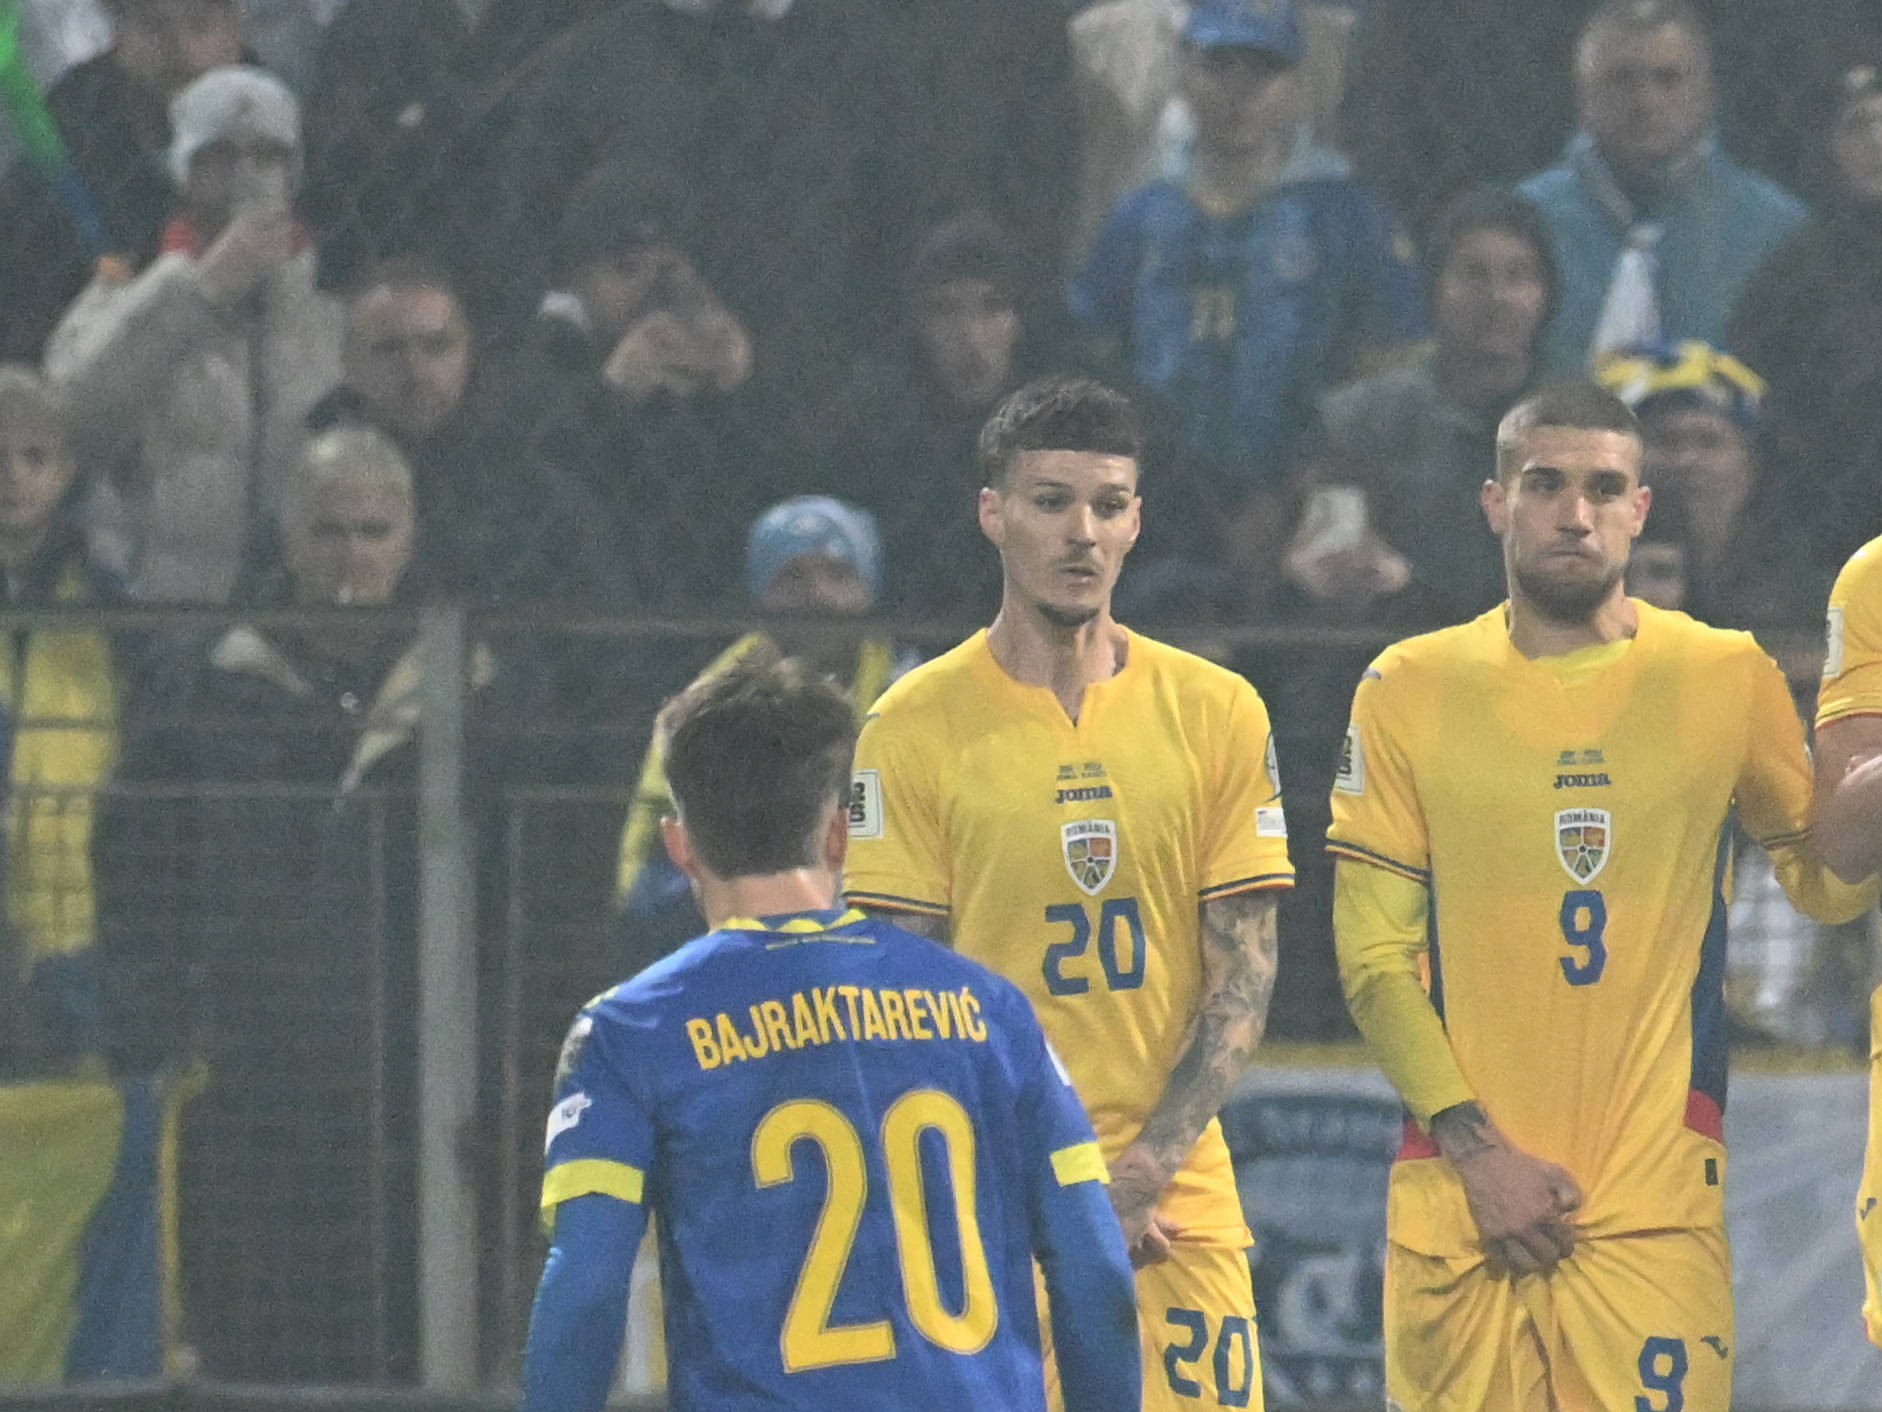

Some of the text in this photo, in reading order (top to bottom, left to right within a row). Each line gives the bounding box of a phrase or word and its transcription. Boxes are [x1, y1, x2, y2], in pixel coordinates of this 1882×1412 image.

[1042, 898, 1146, 996] 20
[1558, 889, 1607, 986] 9
[687, 986, 986, 1070] BAJRAKTAREVIĆ
[751, 1089, 998, 1373] 20
[1164, 1307, 1252, 1407] 20
